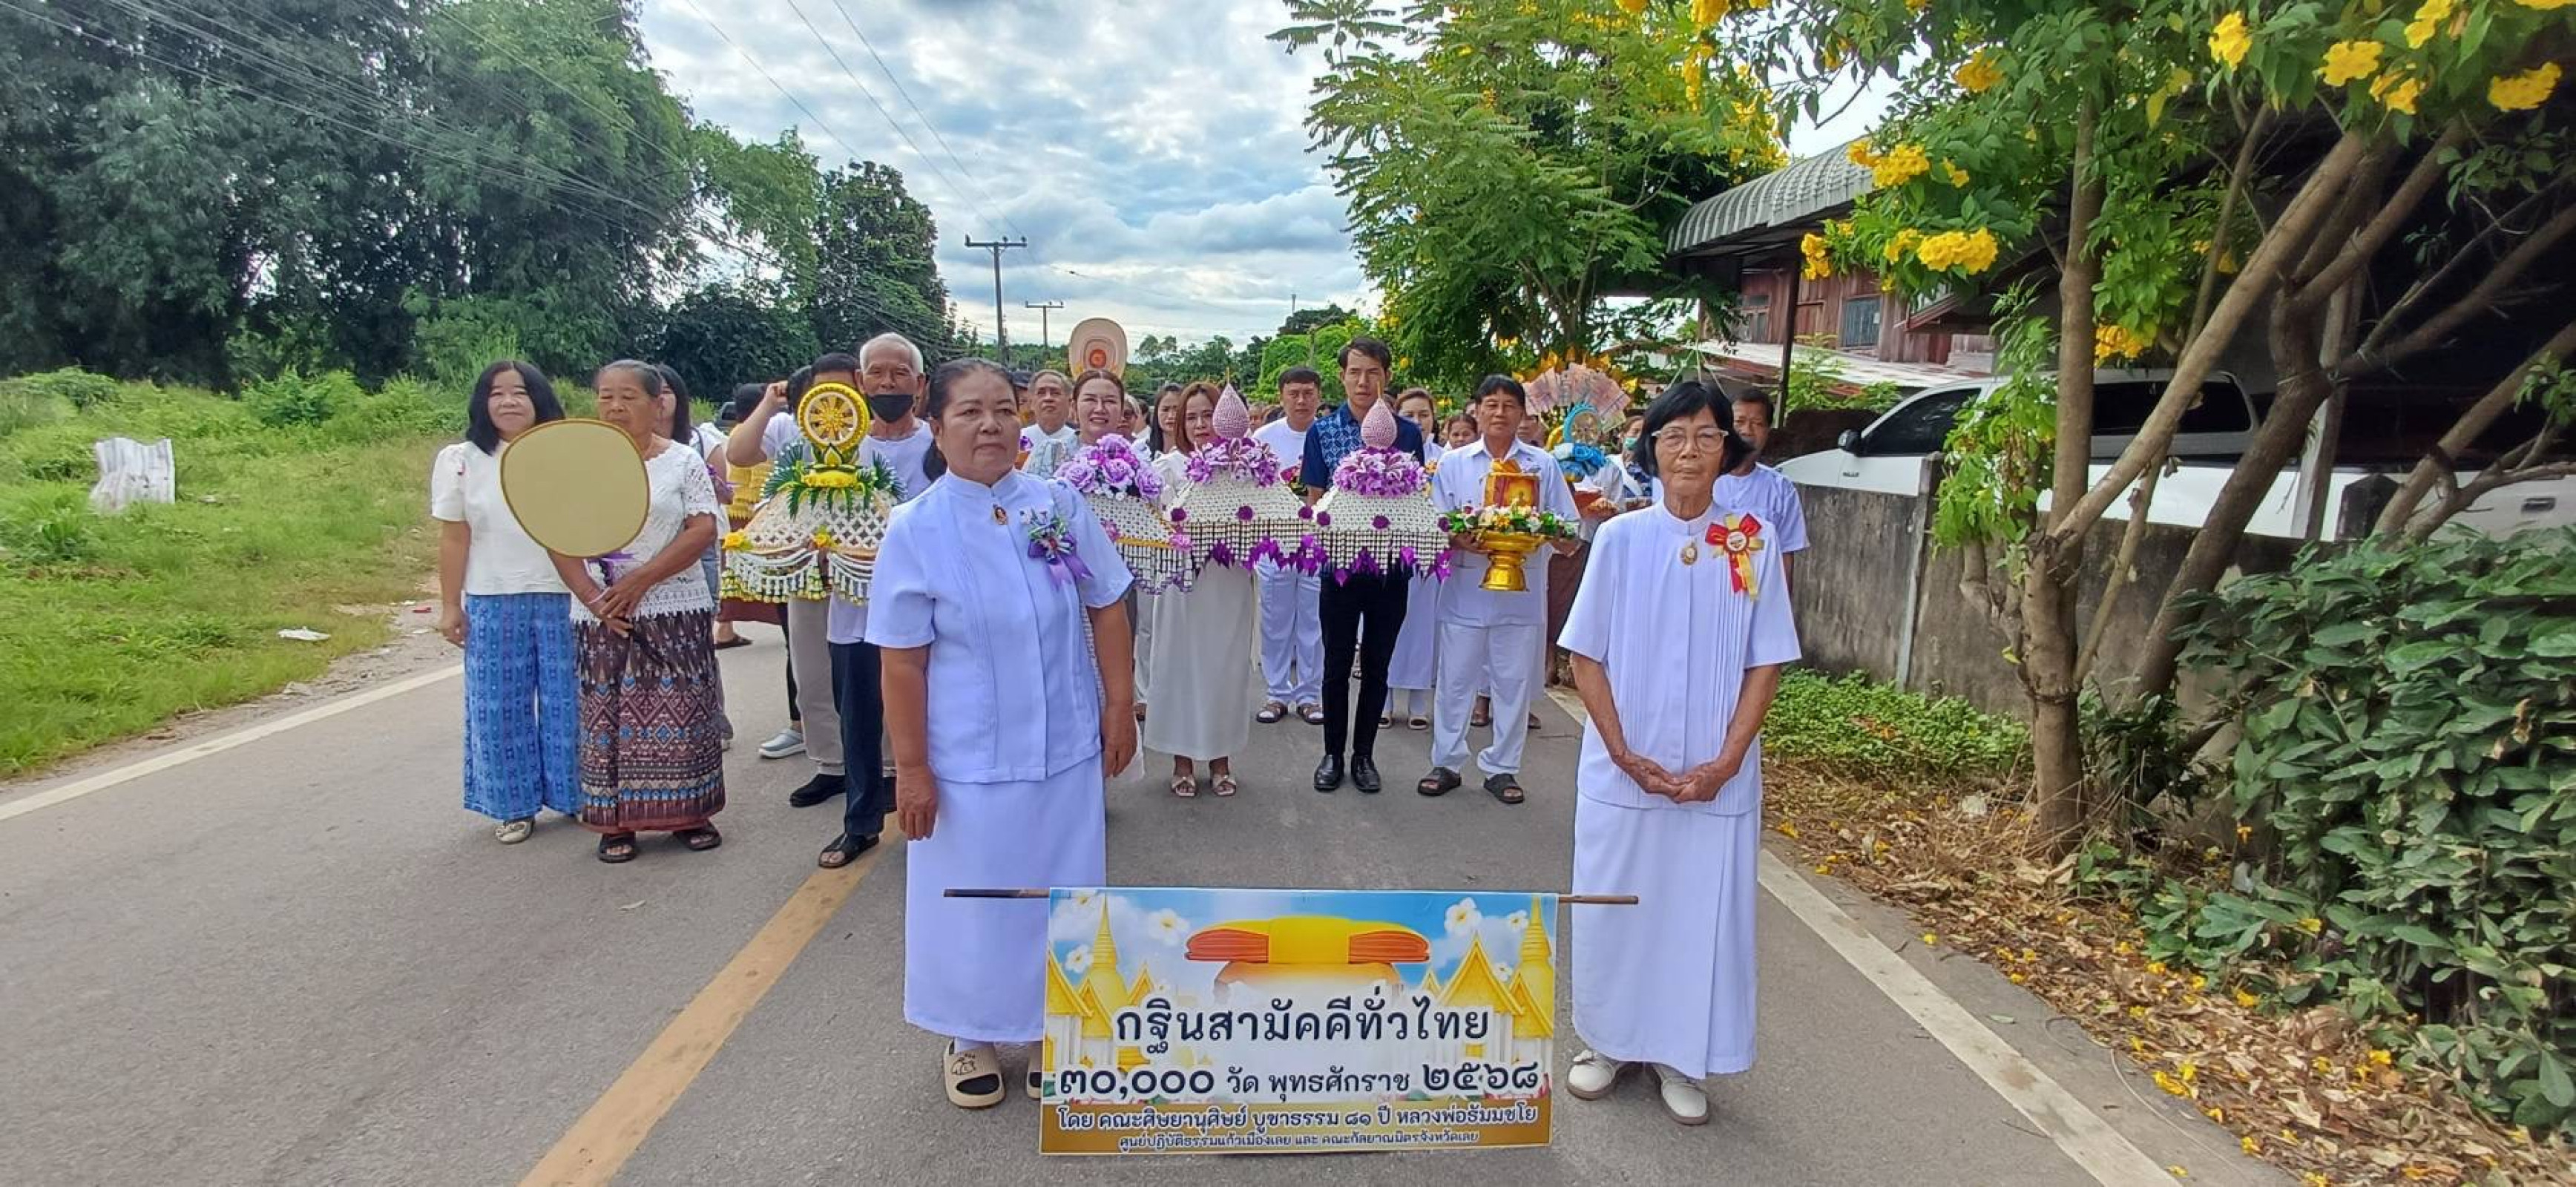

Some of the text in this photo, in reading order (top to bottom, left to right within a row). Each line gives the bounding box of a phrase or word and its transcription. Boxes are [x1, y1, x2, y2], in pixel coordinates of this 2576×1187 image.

[1117, 985, 1488, 1054] กฐินสามัคคีทั่วไทย
[1060, 1062, 1538, 1102] ๓๐,๐๐๐ วัด พุทธศักราช ๒๕๖๘
[1059, 1108, 1093, 1128] โดย
[1099, 1105, 1246, 1131] คณะศิษยานุศิษย์
[1345, 1113, 1371, 1125] ๘๑
[1379, 1105, 1390, 1125] ปี
[1397, 1102, 1537, 1125] หลวงพ่อธัมมชโย
[1295, 1134, 1318, 1145] และ
[1322, 1129, 1479, 1145] คณะกัลยาณมิตรจังหวัดเลย
